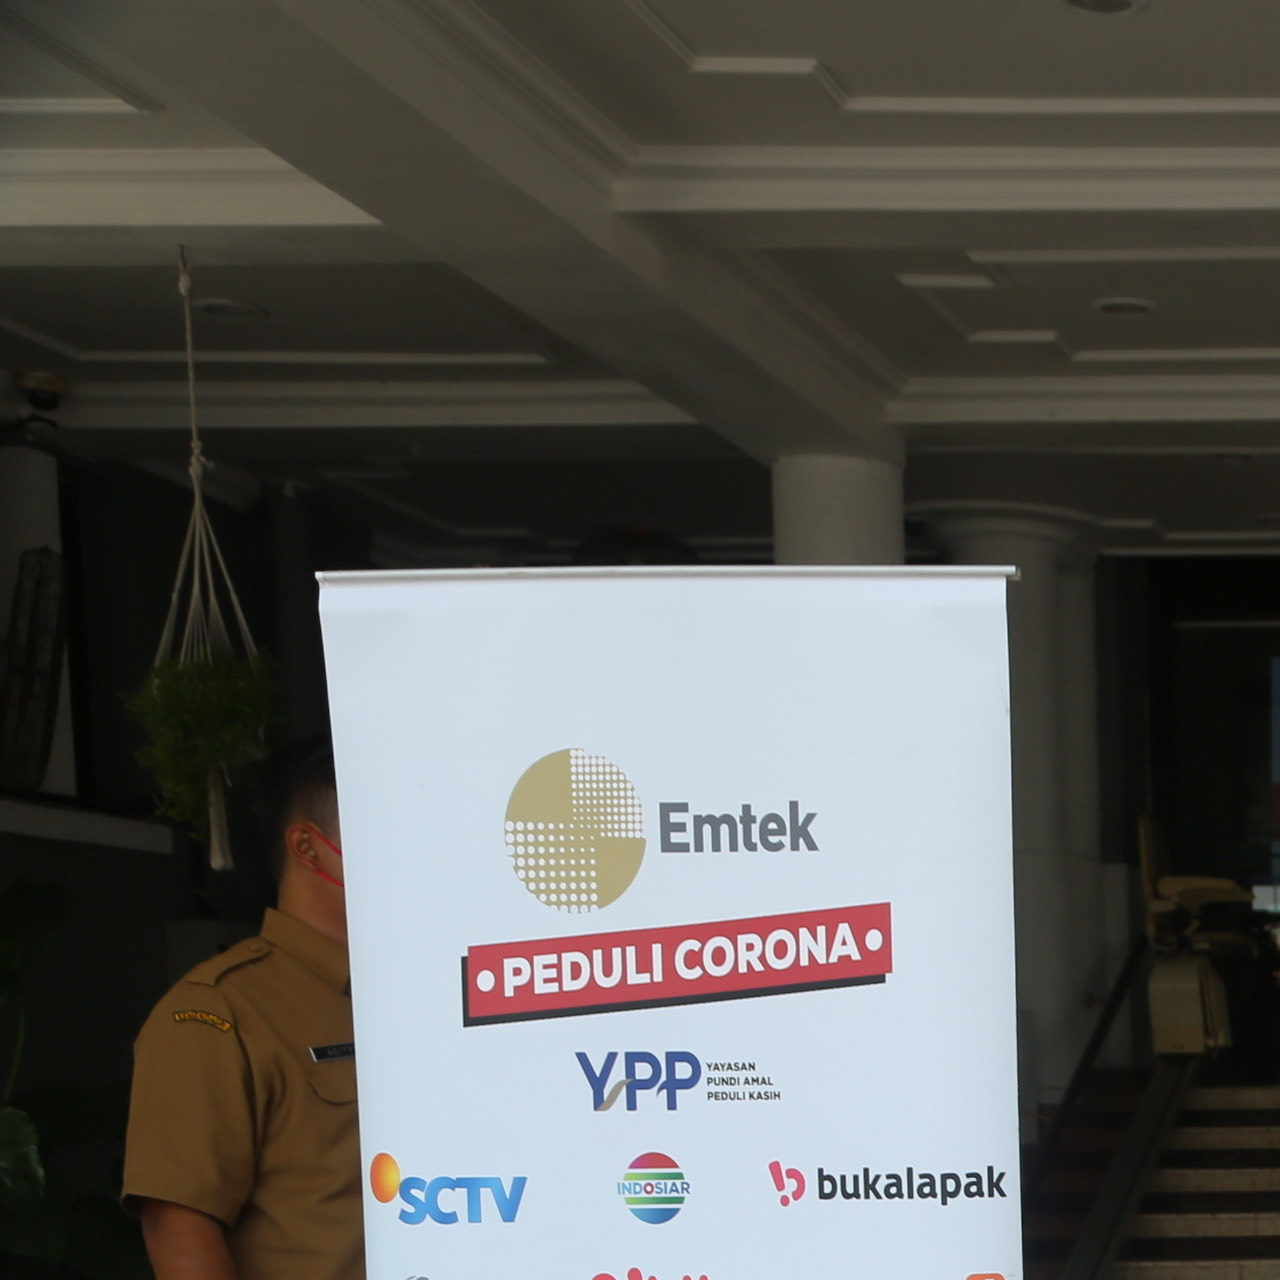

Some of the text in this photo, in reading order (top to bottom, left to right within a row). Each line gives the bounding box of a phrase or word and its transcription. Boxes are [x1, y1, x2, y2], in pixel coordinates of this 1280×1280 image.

[658, 800, 819, 854] Emtek
[502, 923, 861, 998] PEDULI CORONA
[576, 1051, 701, 1111] YPP
[706, 1062, 756, 1072] YAYASAN
[706, 1077, 774, 1086] PUNDI AMAL
[707, 1091, 781, 1101] PEDULI KASIH
[399, 1176, 527, 1225] SCTV
[617, 1181, 691, 1196] INDOSIAR
[818, 1166, 1006, 1205] bukalapak
